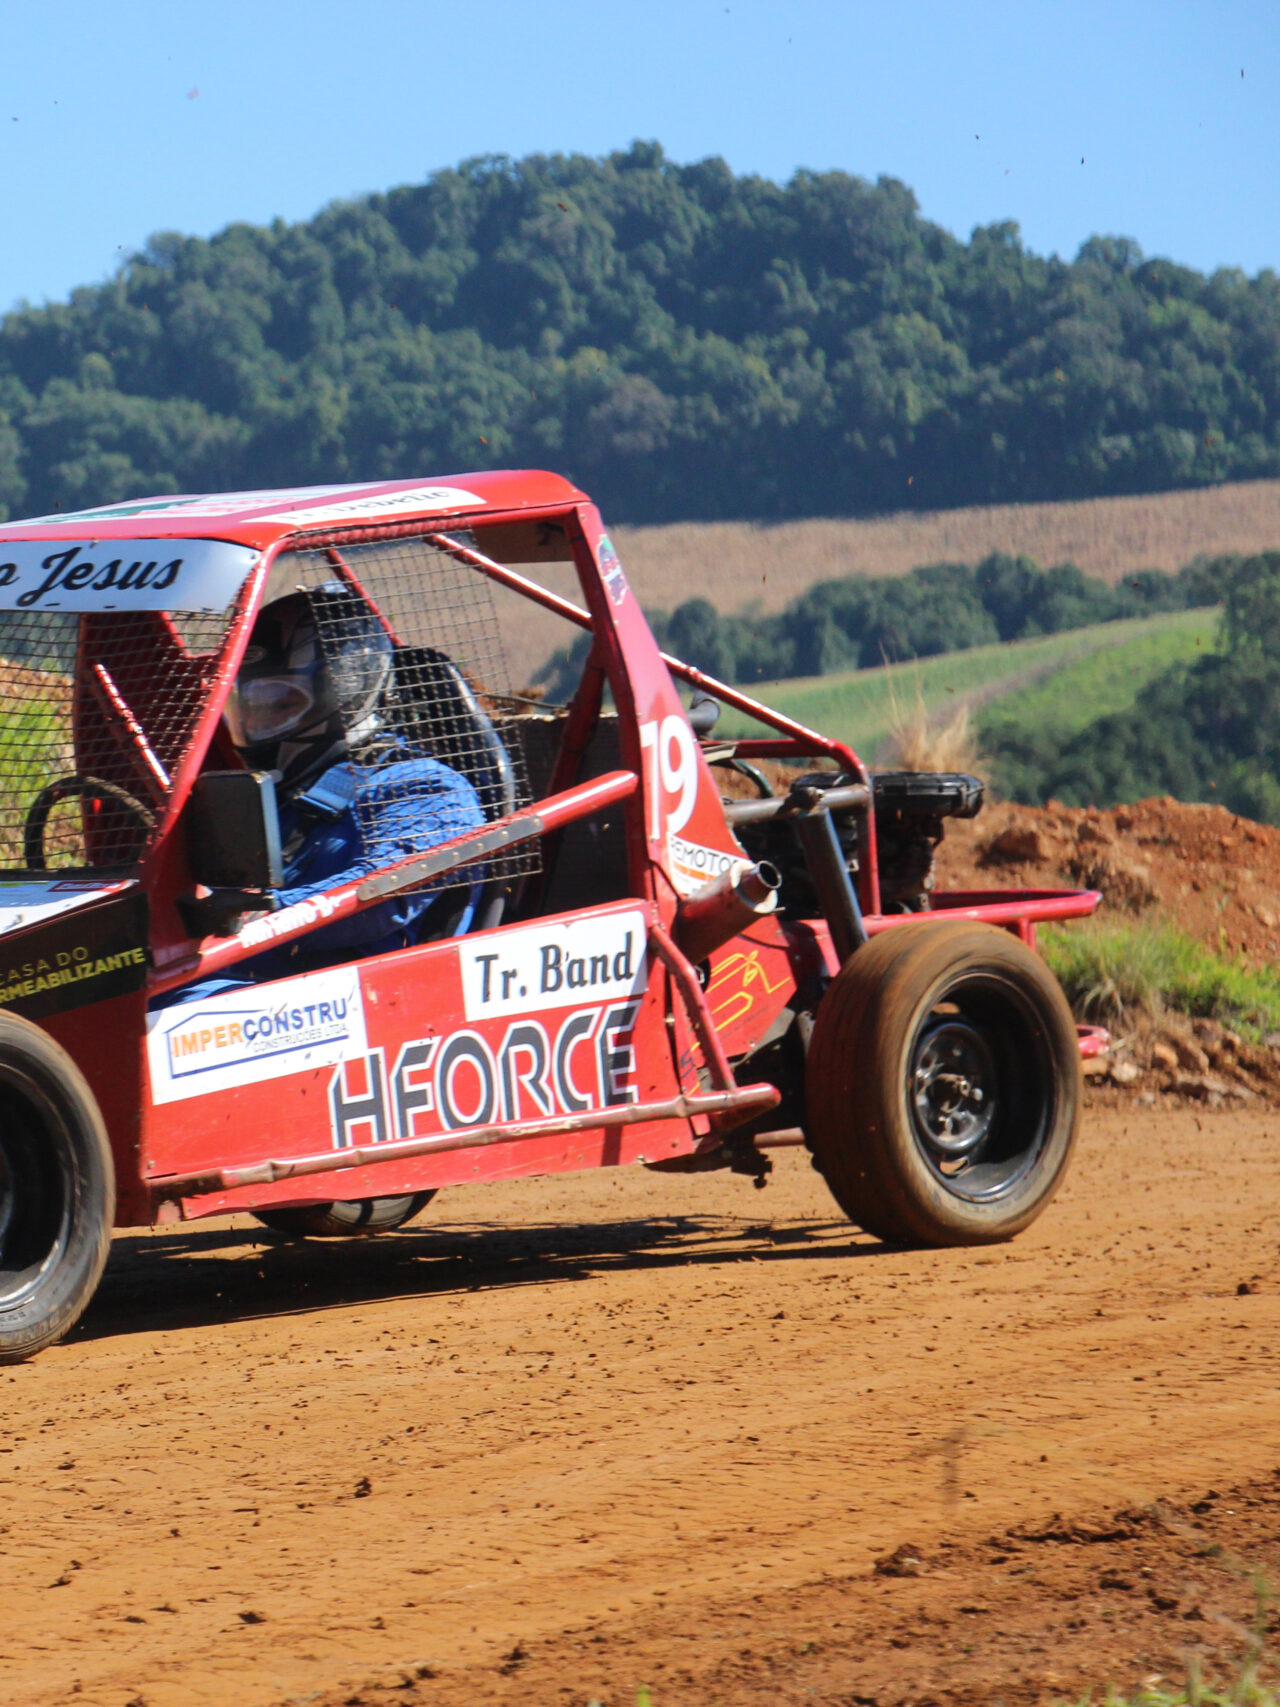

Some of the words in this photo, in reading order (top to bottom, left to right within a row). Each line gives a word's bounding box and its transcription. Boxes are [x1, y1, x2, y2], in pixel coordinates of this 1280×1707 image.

[16, 546, 184, 608] Jesus
[638, 715, 699, 841] 19
[56, 946, 89, 968] DO
[476, 953, 528, 1003] Tr.
[539, 930, 634, 995] Band
[173, 997, 348, 1058] IMPERCONSTRU
